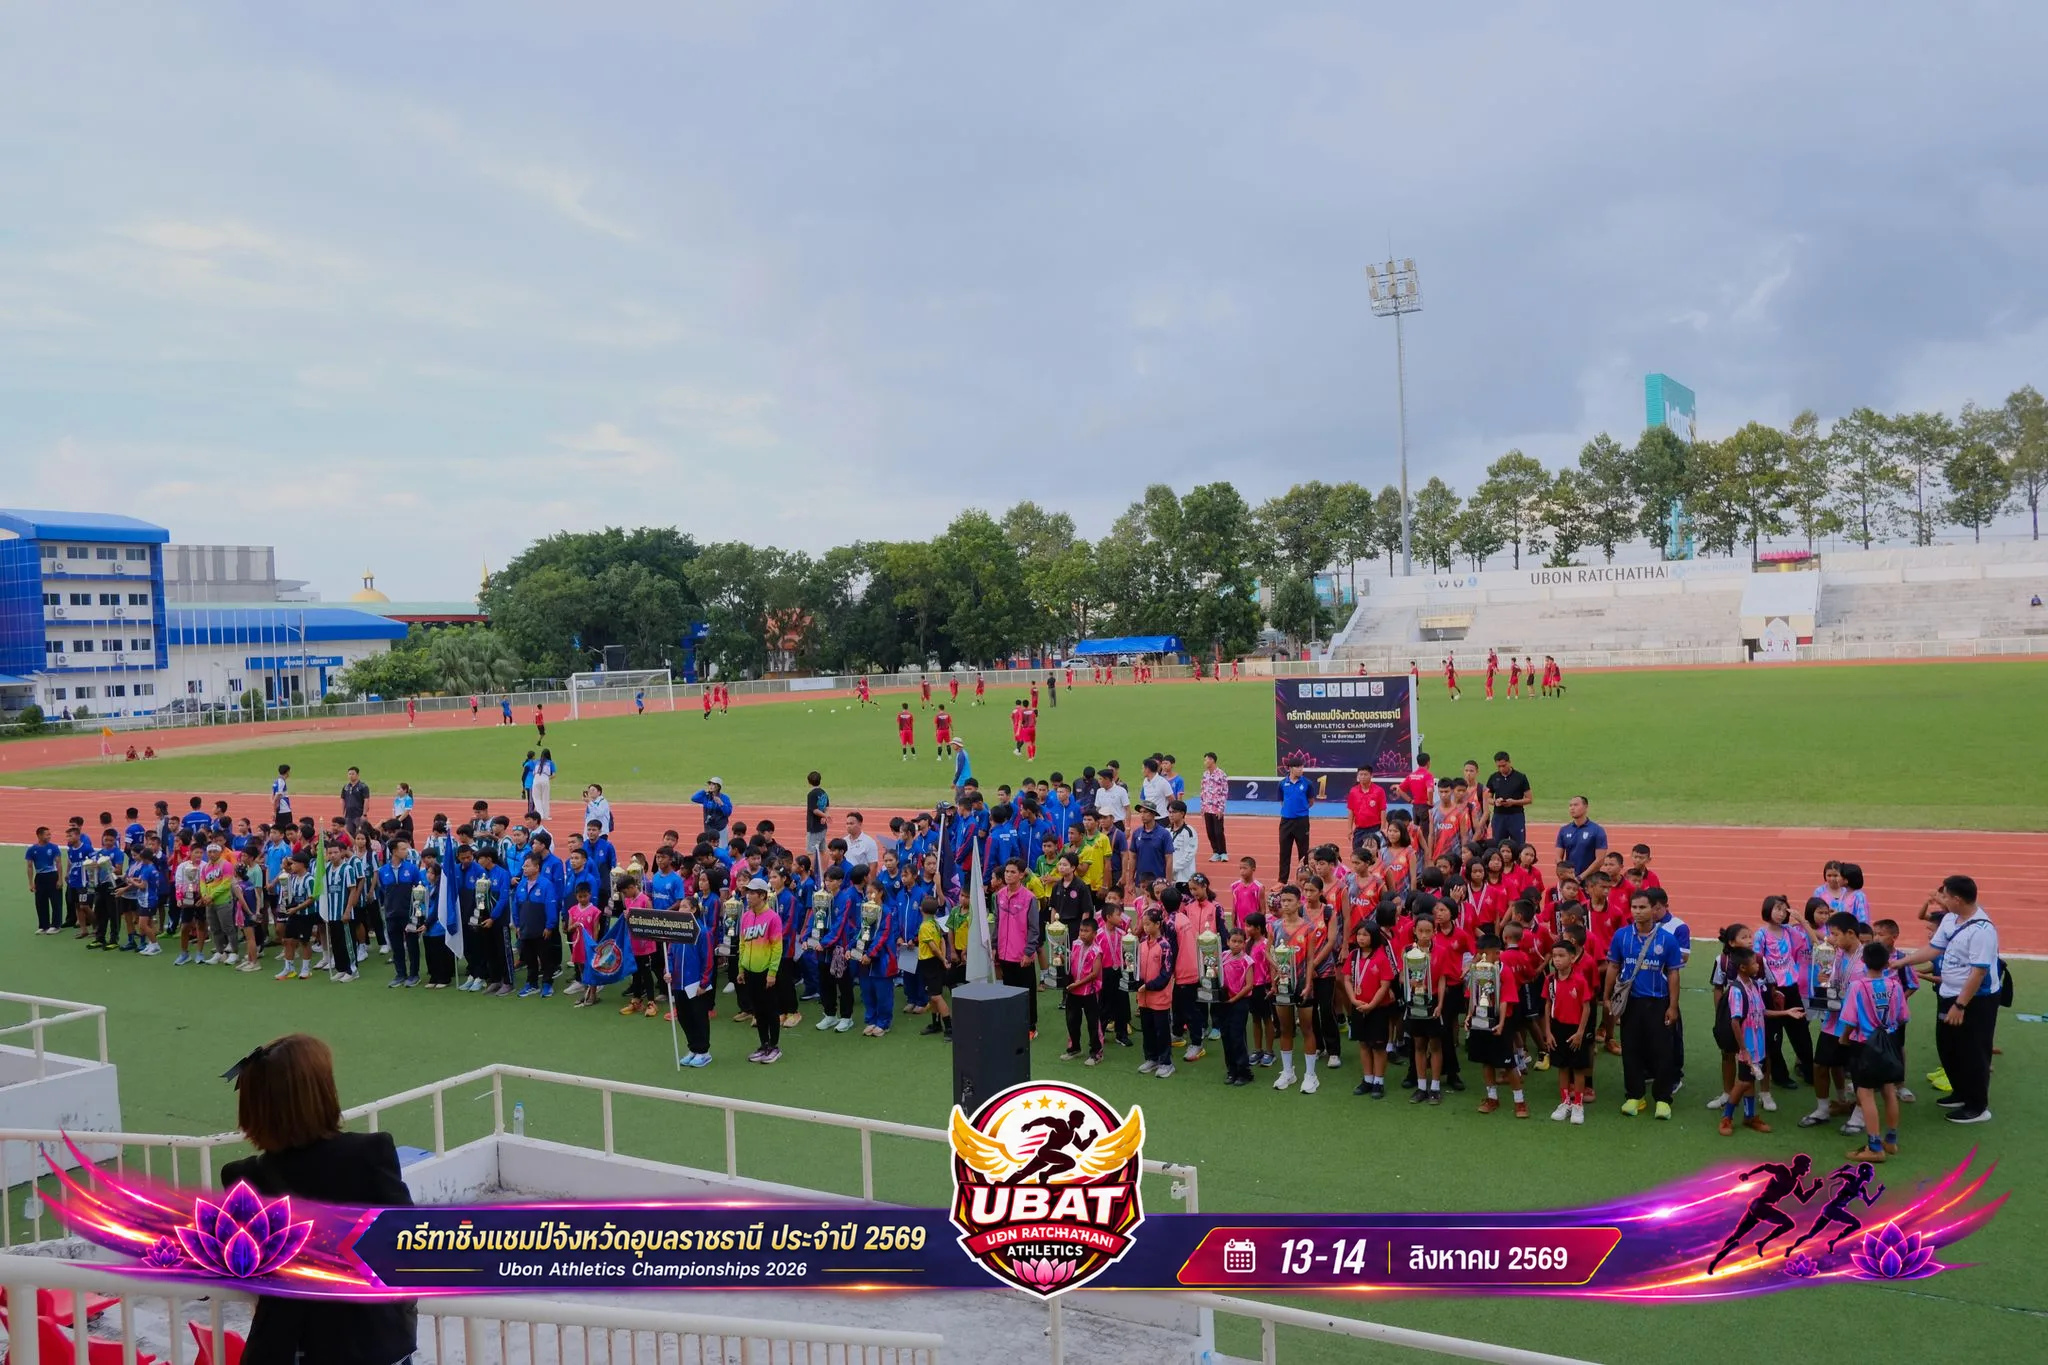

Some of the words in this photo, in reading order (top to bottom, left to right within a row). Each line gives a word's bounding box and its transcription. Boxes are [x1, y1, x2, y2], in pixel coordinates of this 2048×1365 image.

[1530, 571, 1572, 586] UBON
[1245, 781, 1259, 799] 2
[1316, 775, 1327, 799] 1
[1350, 896, 1370, 906] KNP
